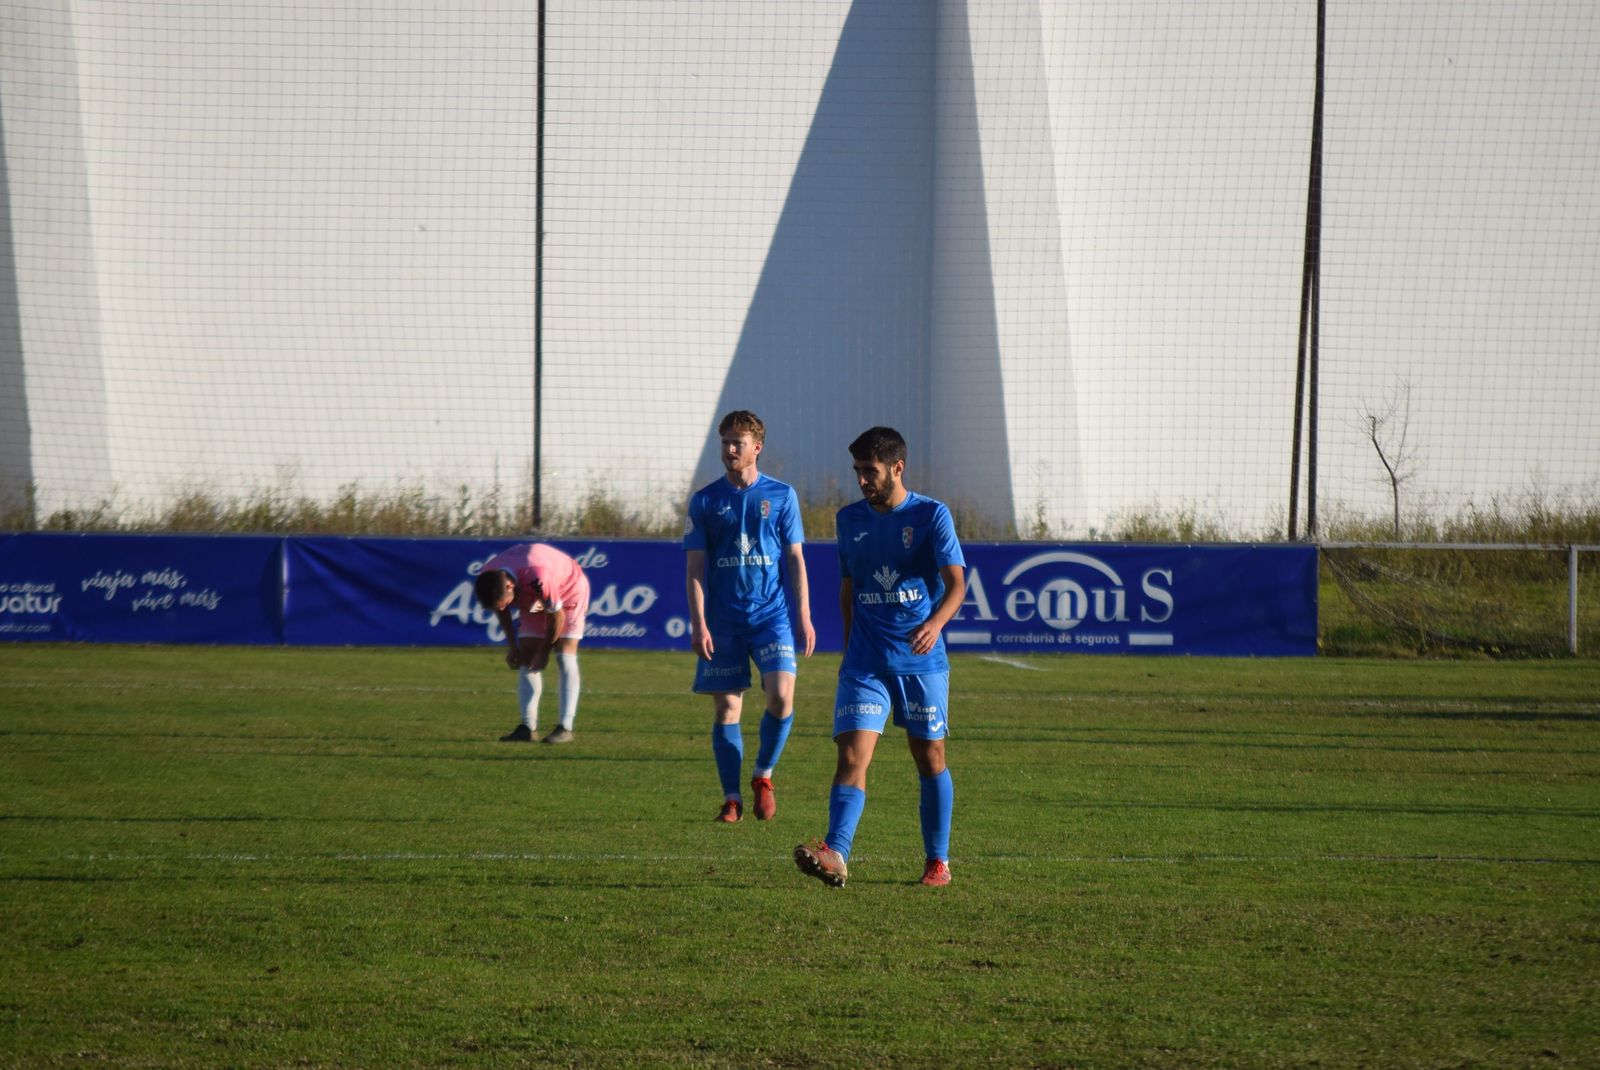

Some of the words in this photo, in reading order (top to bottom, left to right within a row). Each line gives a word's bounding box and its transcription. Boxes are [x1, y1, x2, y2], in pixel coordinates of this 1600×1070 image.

[81, 569, 136, 600] viaja
[132, 590, 175, 611] vive
[179, 588, 221, 610] más
[885, 589, 922, 603] RURAL
[1057, 632, 1072, 644] de
[1075, 634, 1120, 645] seguros
